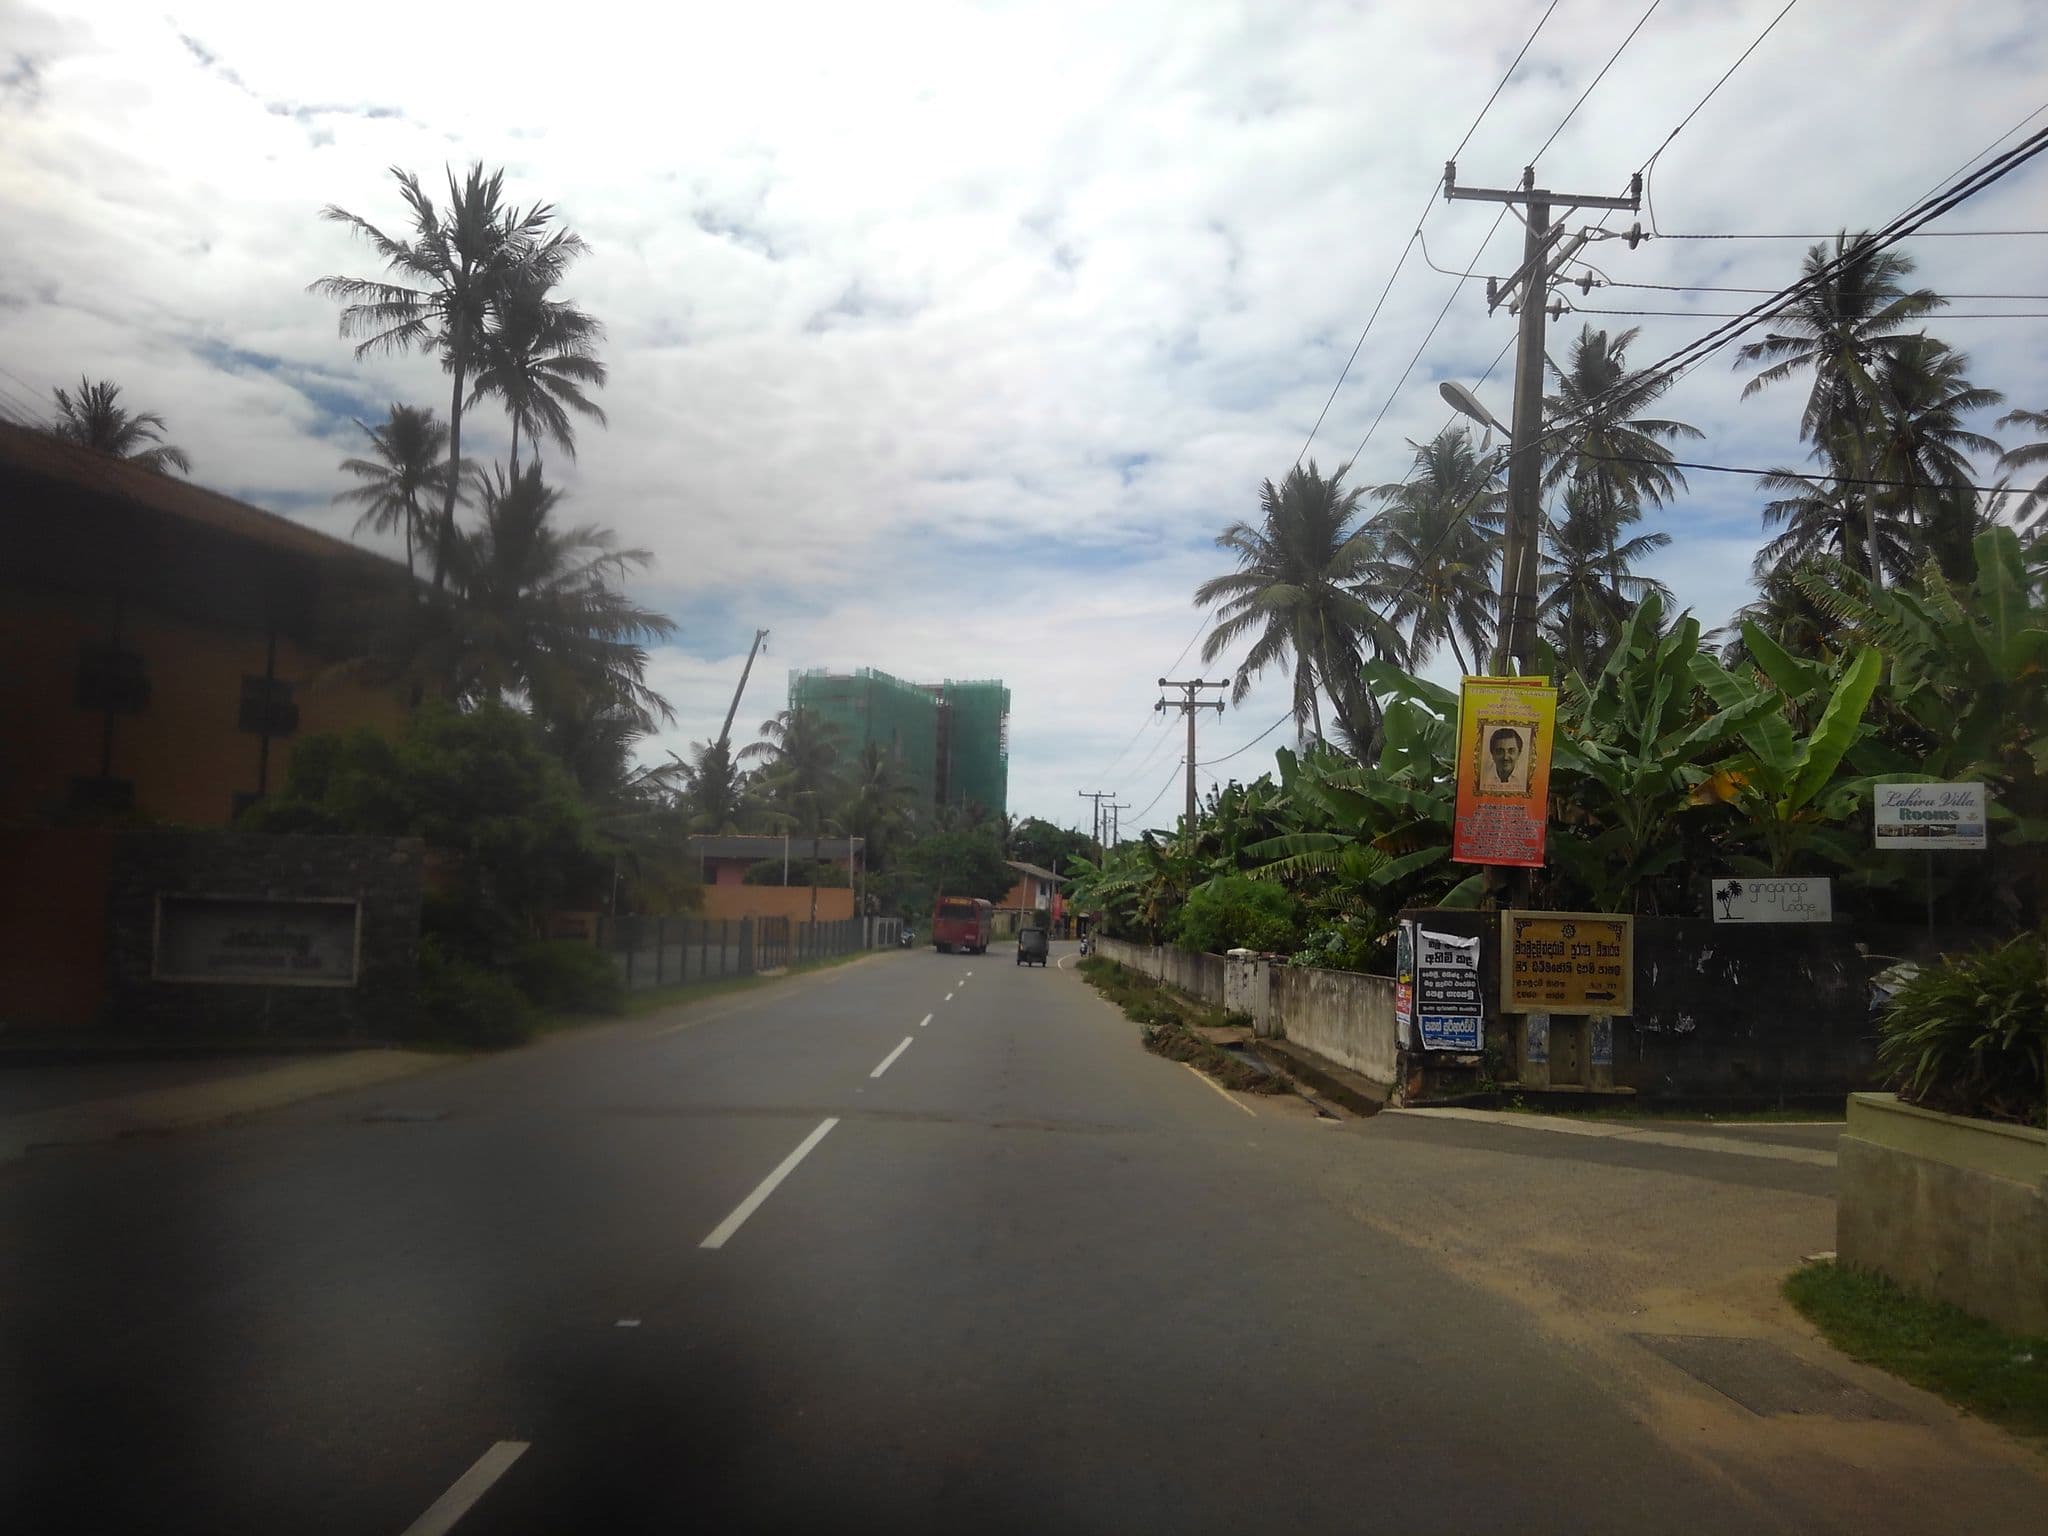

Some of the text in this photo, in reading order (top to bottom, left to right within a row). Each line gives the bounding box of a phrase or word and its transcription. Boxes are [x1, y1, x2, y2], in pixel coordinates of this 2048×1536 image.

[1882, 788, 1975, 807] Lahiru Villa
[1899, 807, 1960, 820] Rooms
